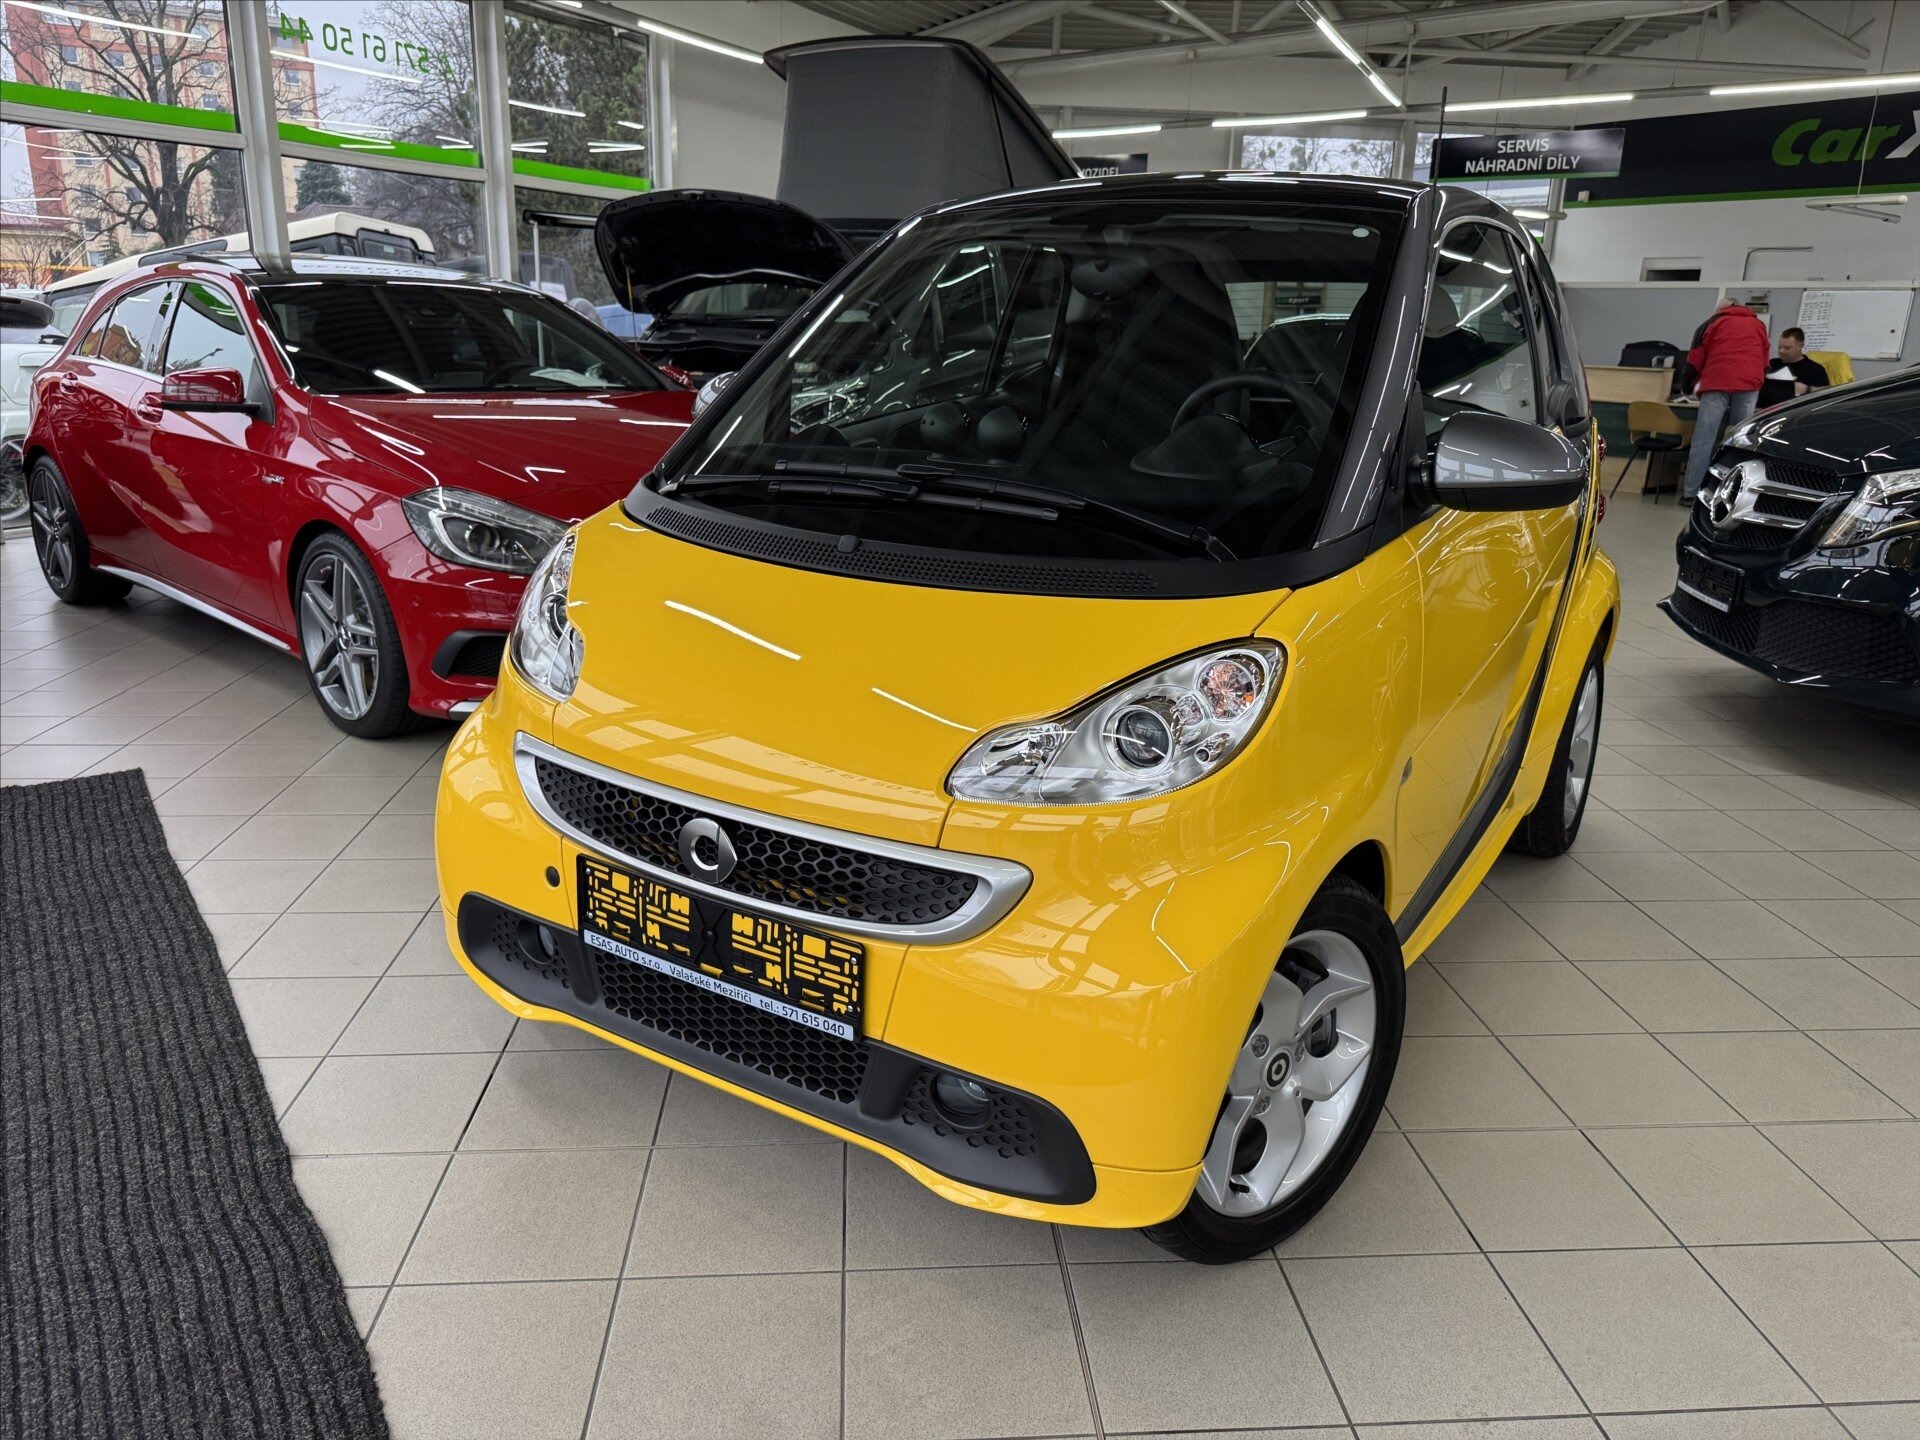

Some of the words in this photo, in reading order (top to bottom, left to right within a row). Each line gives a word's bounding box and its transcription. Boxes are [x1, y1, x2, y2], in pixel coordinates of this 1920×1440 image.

[1497, 138, 1550, 154] SERVIS
[1465, 154, 1544, 174] NÁHRADNÍ
[1546, 153, 1581, 171] DÍLY
[591, 934, 613, 952] ESAS
[615, 944, 640, 962] AUTO
[641, 956, 663, 972] s.r.o.
[669, 964, 711, 989] Valašské
[713, 981, 752, 1004] Meziříčí
[760, 998, 780, 1014] tel.:
[782, 1005, 800, 1021] 571
[801, 1012, 820, 1028] 615
[822, 1020, 845, 1036] 040
